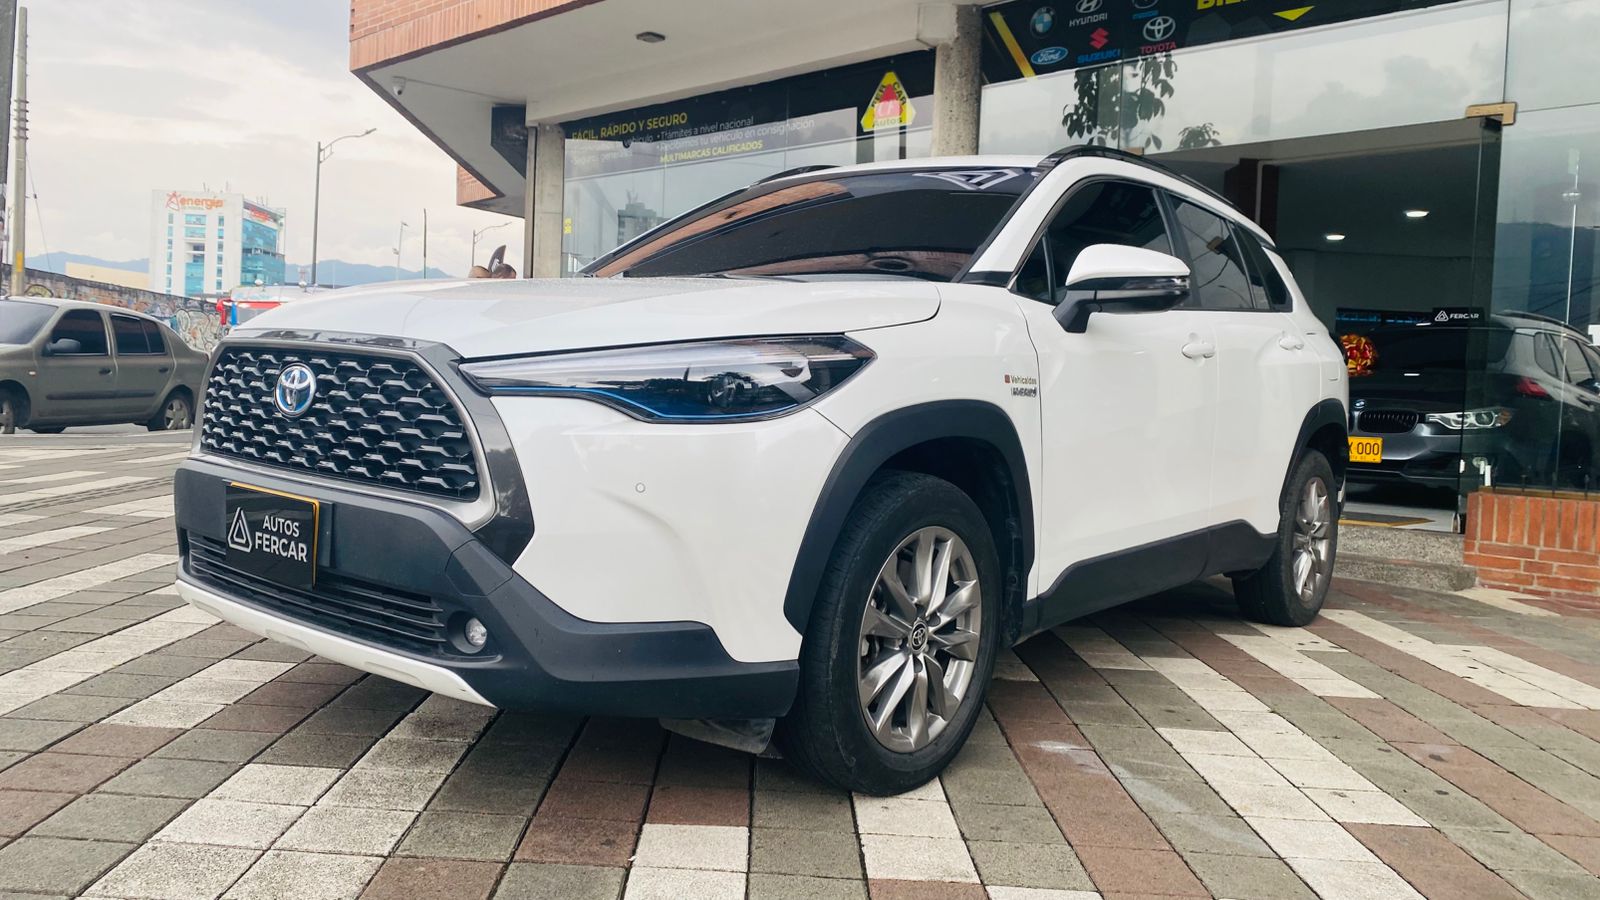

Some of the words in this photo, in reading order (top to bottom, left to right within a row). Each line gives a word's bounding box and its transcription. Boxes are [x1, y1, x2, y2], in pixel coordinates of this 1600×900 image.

[1069, 13, 1108, 27] HYUNDAI
[1077, 48, 1120, 64] SUZUKI
[1140, 42, 1177, 55] TOYOTA
[600, 121, 636, 138] RÁPIDO
[639, 121, 646, 131] Y
[647, 112, 688, 130] SEGURO
[700, 121, 719, 134] nivel
[719, 116, 754, 131] nacional
[745, 130, 755, 139] en
[712, 140, 764, 156] CALIFICADOS
[1357, 442, 1380, 456] 000
[262, 515, 300, 538] AUTOS
[255, 531, 308, 563] FERCAR
